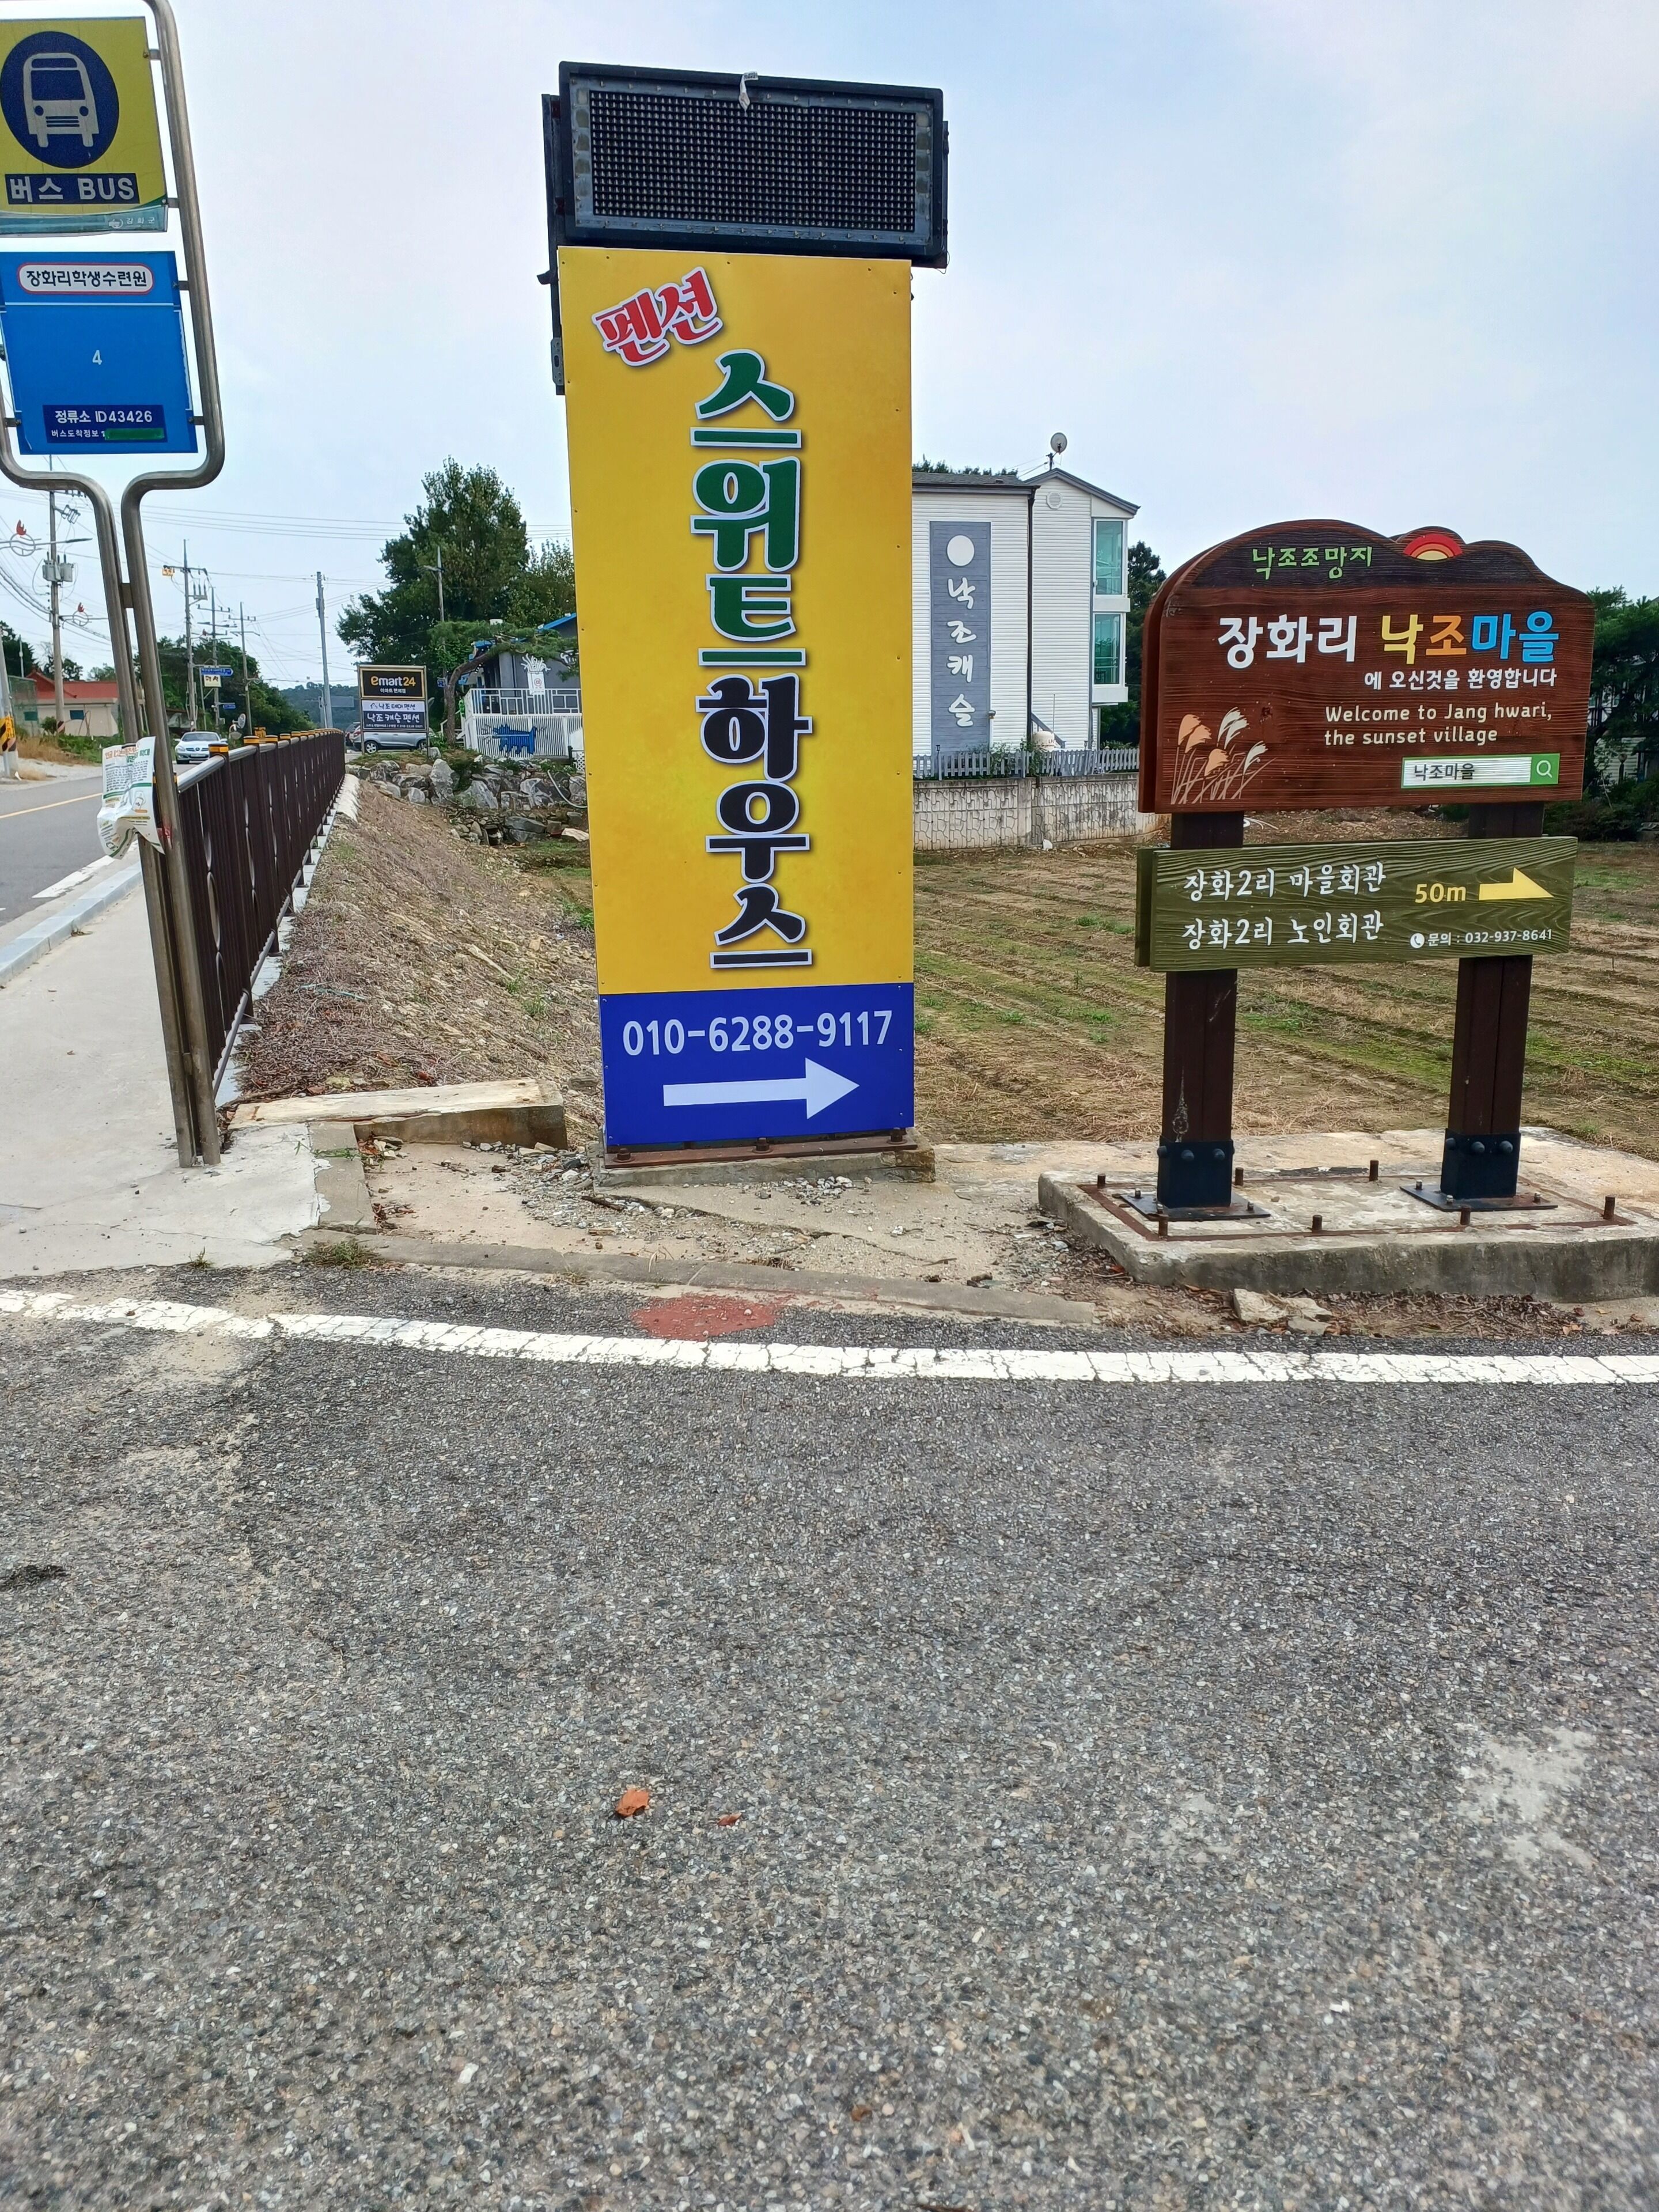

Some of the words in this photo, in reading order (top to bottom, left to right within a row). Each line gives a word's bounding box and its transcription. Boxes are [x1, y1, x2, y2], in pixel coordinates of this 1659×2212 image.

[10, 176, 64, 203] 버스
[78, 178, 135, 200] BUS
[26, 270, 147, 287] 장화리학생수련원
[592, 266, 724, 366] 펜션
[92, 350, 103, 365] 4
[55, 410, 91, 423] 정류소
[95, 411, 153, 422] ID43426
[51, 429, 99, 438] 버스도착정보
[1252, 546, 1374, 579] 낙조조망지
[1218, 613, 1358, 669] 장화리
[1381, 611, 1560, 664] 낙조마을
[946, 577, 977, 728] 낙조캐슬
[370, 676, 416, 686] emart24
[1364, 671, 1382, 690] 에
[1389, 669, 1460, 690] 오신것을
[1468, 667, 1557, 688] 환영합니다
[1325, 706, 1410, 722] Welcome
[1418, 704, 1437, 720] to
[1444, 703, 1487, 722] Jang
[1495, 702, 1552, 721] hwari,
[1325, 730, 1353, 745] the
[1362, 728, 1426, 744] sunset
[1434, 726, 1498, 745] village
[1414, 763, 1475, 781] 낙조마을
[1183, 869, 1275, 902] 장화2리
[1289, 861, 1386, 896] 마을회관
[1415, 883, 1467, 903] 50m
[1181, 917, 1273, 950] 장화2리
[1287, 910, 1385, 945] 노인회관
[1427, 932, 1452, 946] 문의
[1465, 929, 1553, 943] 032-937-8641
[623, 1010, 892, 1056] 010-6288-9117
